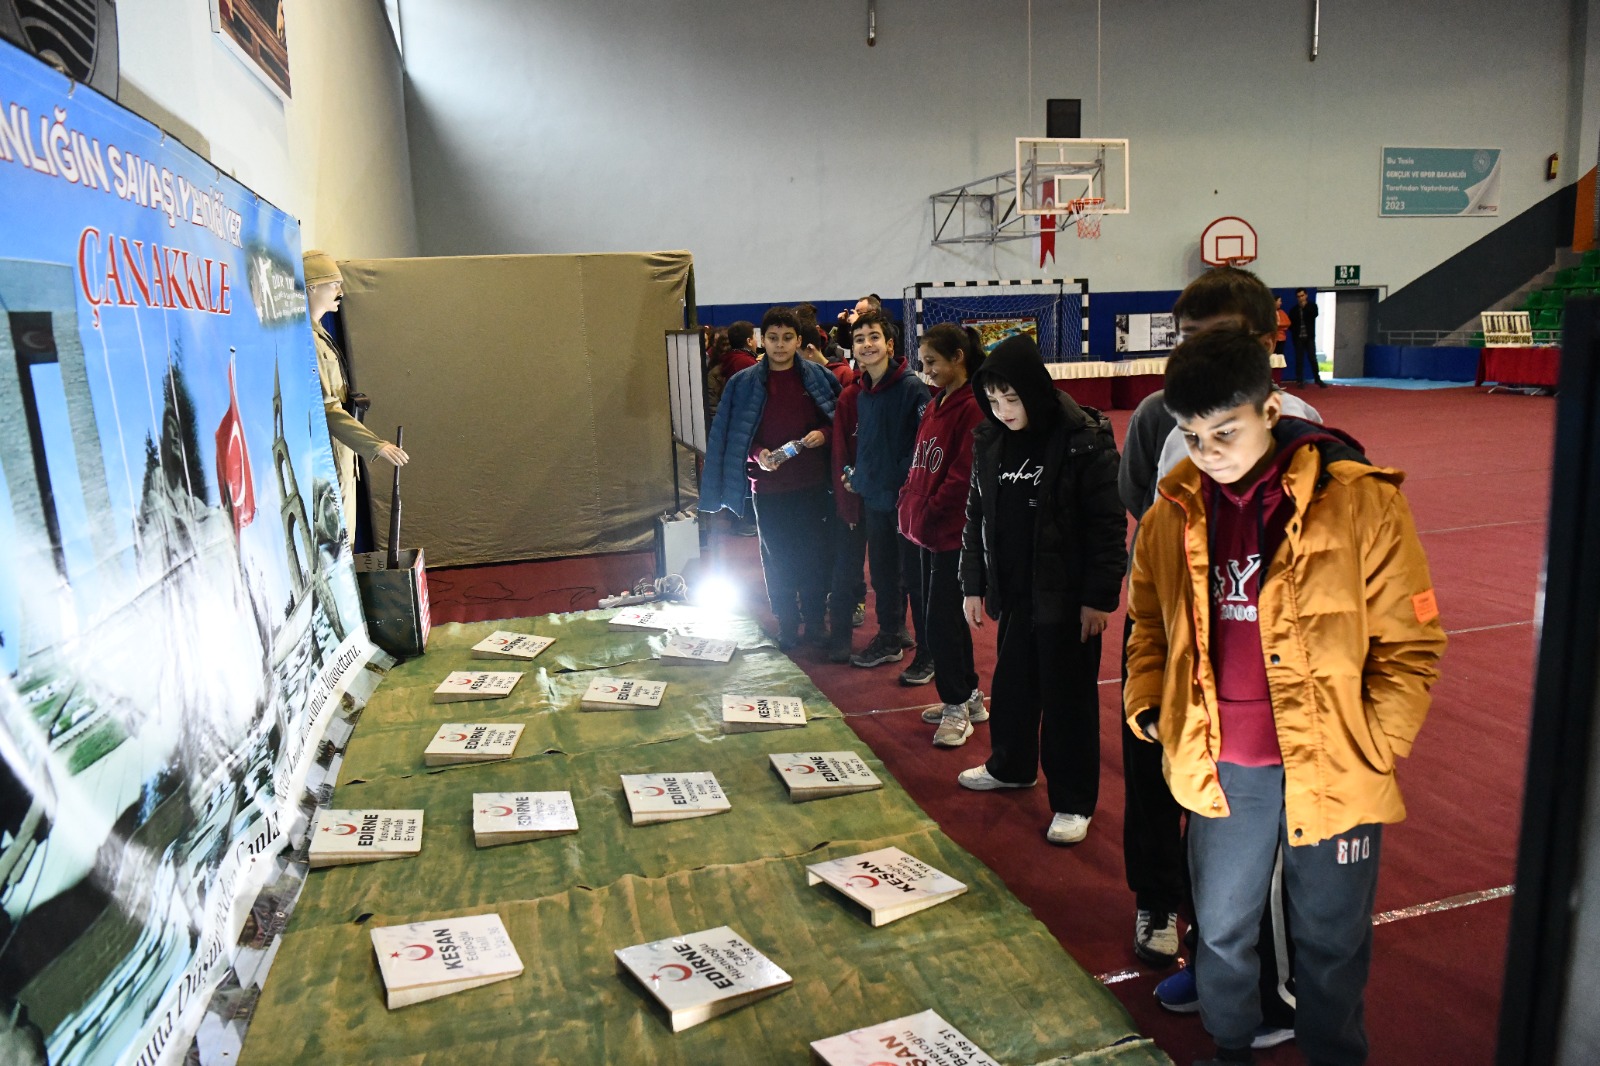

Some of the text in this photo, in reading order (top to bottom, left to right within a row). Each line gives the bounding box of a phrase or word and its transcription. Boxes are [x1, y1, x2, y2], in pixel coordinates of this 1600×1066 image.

[0, 101, 111, 194] NLIĞIN
[1387, 157, 1396, 165] Bu
[1385, 201, 1405, 210] 2023
[77, 227, 232, 327] ÇANAKKALE
[757, 699, 771, 718] KEŞAN
[809, 756, 839, 781] EDİRNE
[663, 777, 687, 804] EDİRNE
[512, 796, 533, 825] EDİRNE
[357, 814, 378, 846] EDİRNE
[378, 818, 393, 842] Yusufoğlu
[391, 819, 403, 840] Emrullah
[405, 825, 416, 834] Yaş
[857, 861, 916, 892] KEŞAN
[897, 863, 926, 878] Hasan
[433, 928, 463, 970] KEŞAN
[458, 931, 479, 961] Edipoğlu
[475, 936, 491, 951] Halil
[673, 944, 734, 989] EDİRNE
[938, 1029, 956, 1040] 31
[880, 1036, 927, 1066] ŞAN
[905, 1031, 950, 1066] metoğlu
[955, 1041, 976, 1059] Yaş
